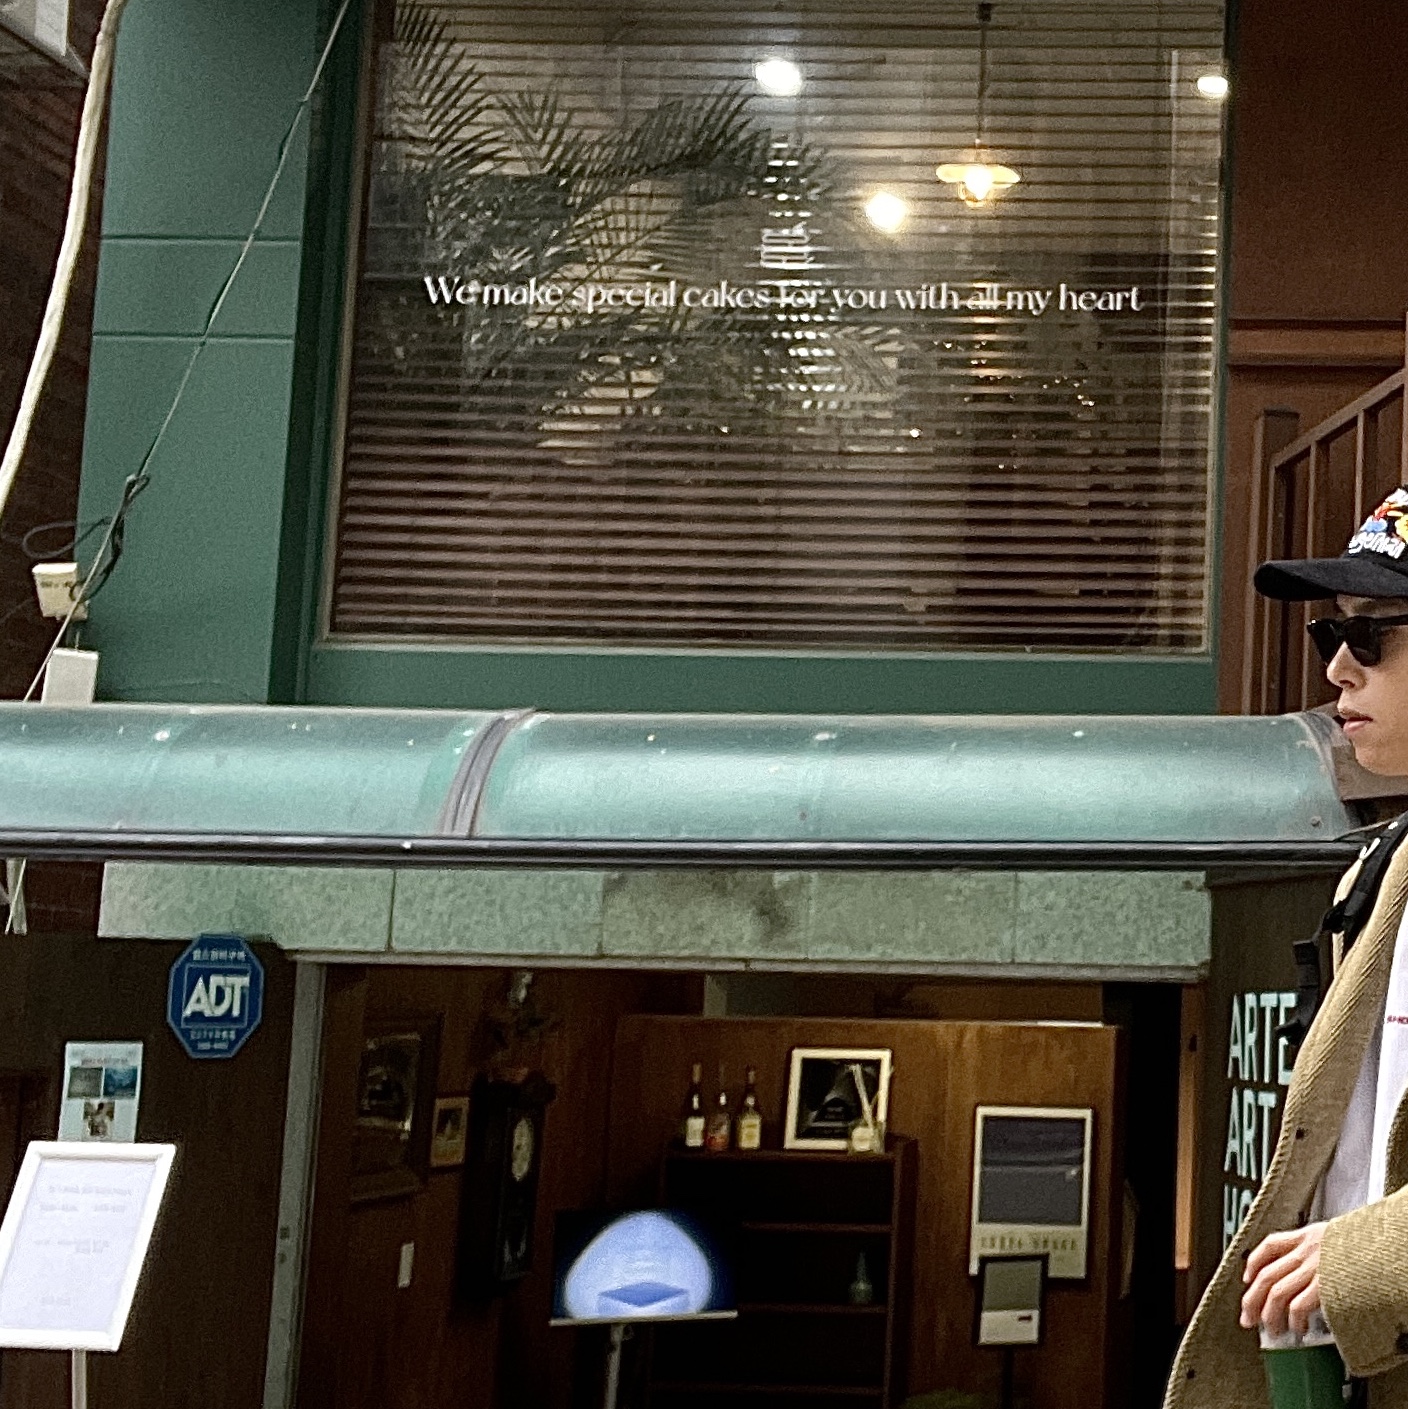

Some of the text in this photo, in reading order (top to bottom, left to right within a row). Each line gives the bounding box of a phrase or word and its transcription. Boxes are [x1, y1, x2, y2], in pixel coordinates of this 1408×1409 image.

[424, 274, 1143, 315] We make special cakes for you with all my heart
[183, 974, 250, 1017] ADT
[1224, 1086, 1277, 1182] ART
